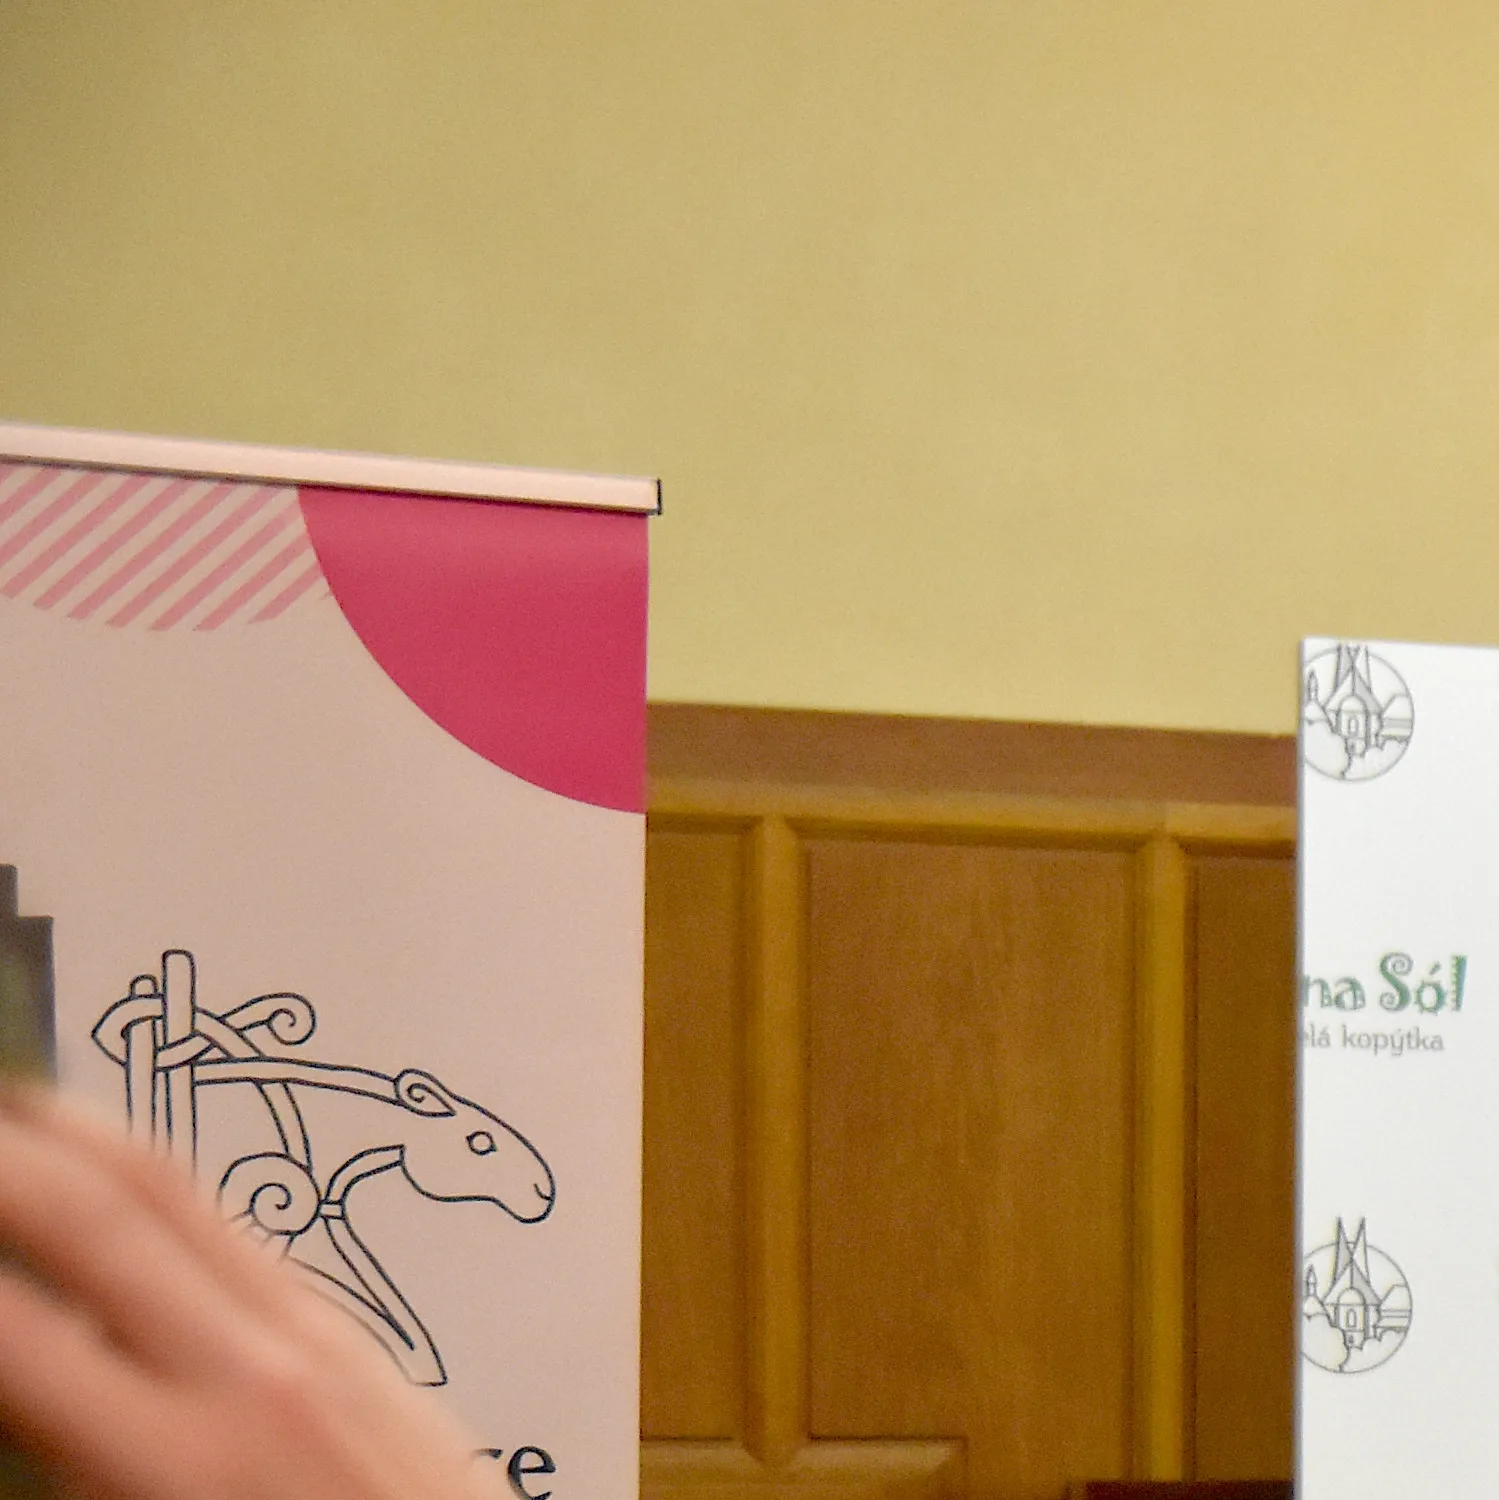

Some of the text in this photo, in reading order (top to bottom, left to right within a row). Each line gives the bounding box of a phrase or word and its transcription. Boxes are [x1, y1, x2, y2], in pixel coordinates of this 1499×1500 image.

[1302, 952, 1468, 1014] na Sól
[1342, 1023, 1445, 1057] kopýtka
